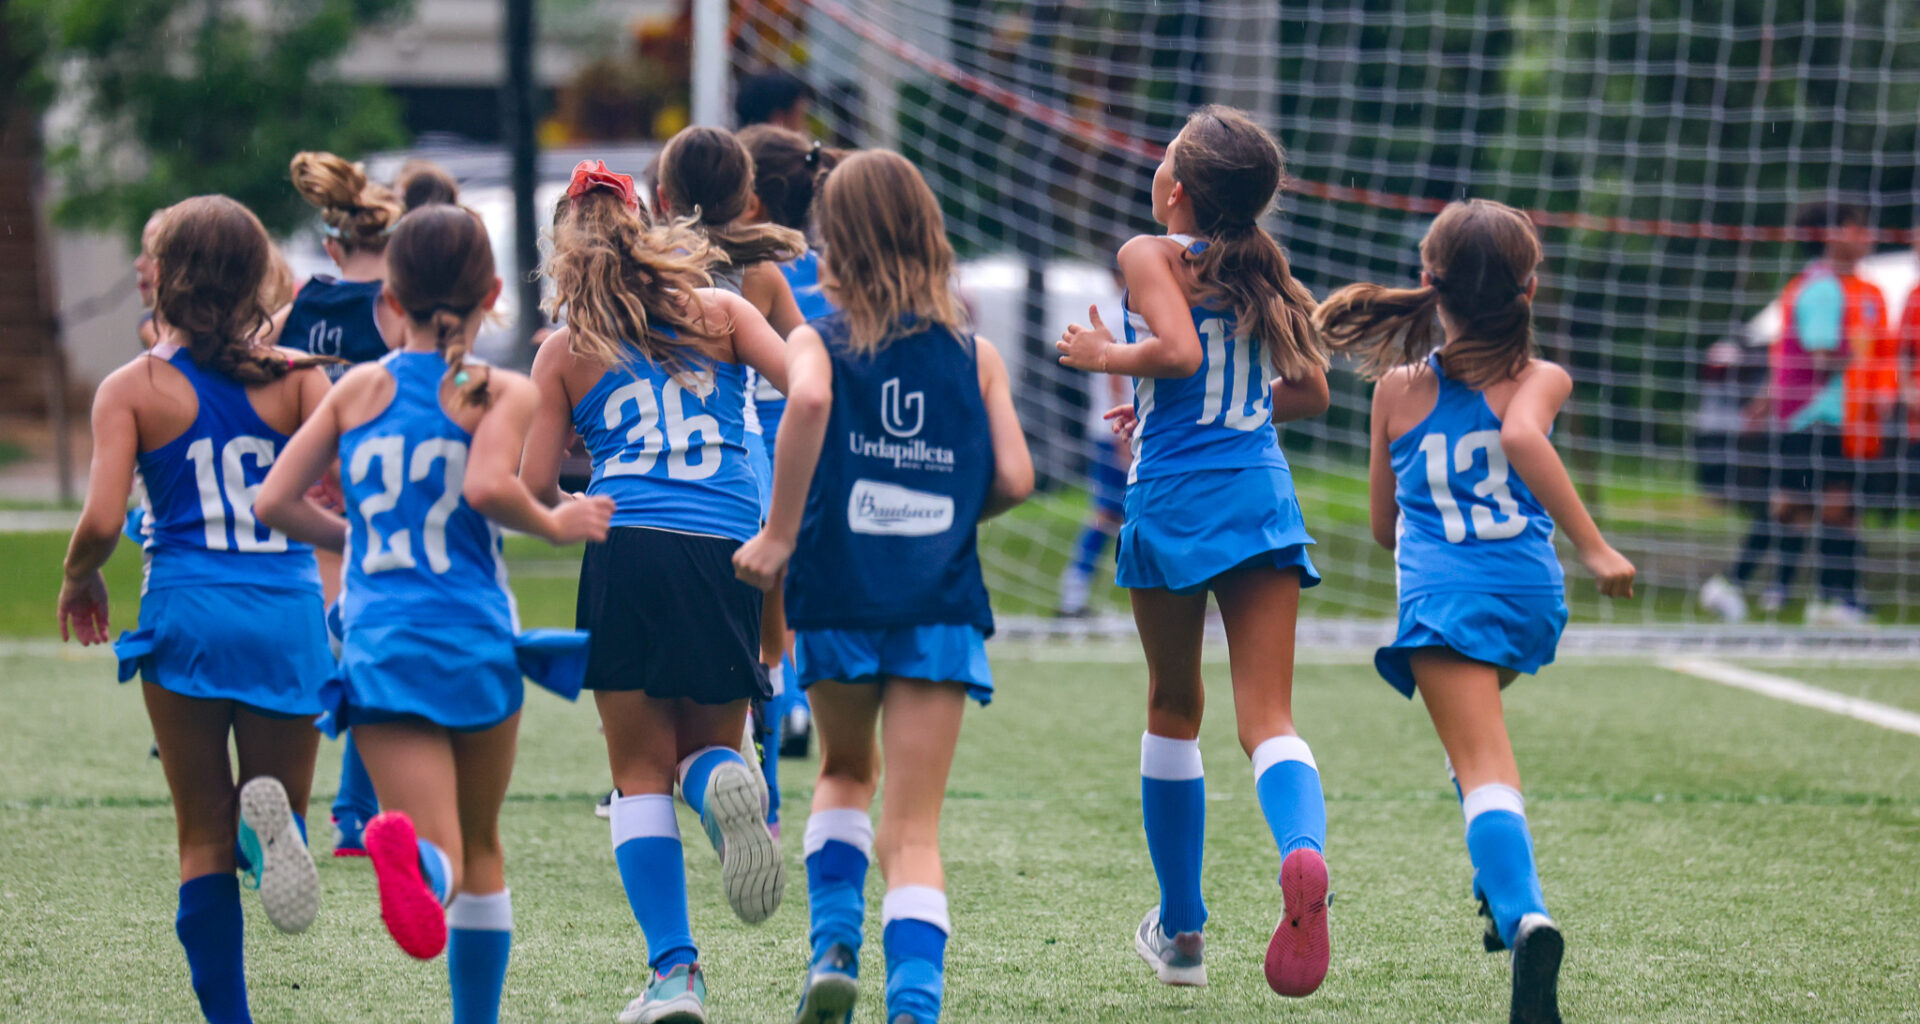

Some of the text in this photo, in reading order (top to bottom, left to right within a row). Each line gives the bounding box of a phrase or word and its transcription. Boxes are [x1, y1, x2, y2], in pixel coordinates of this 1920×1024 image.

[602, 371, 724, 481] 36
[1196, 318, 1271, 432] 10
[186, 435, 288, 552] 16
[350, 435, 467, 574] 27
[850, 431, 955, 468] Urdapilleta
[1419, 429, 1528, 544] 13
